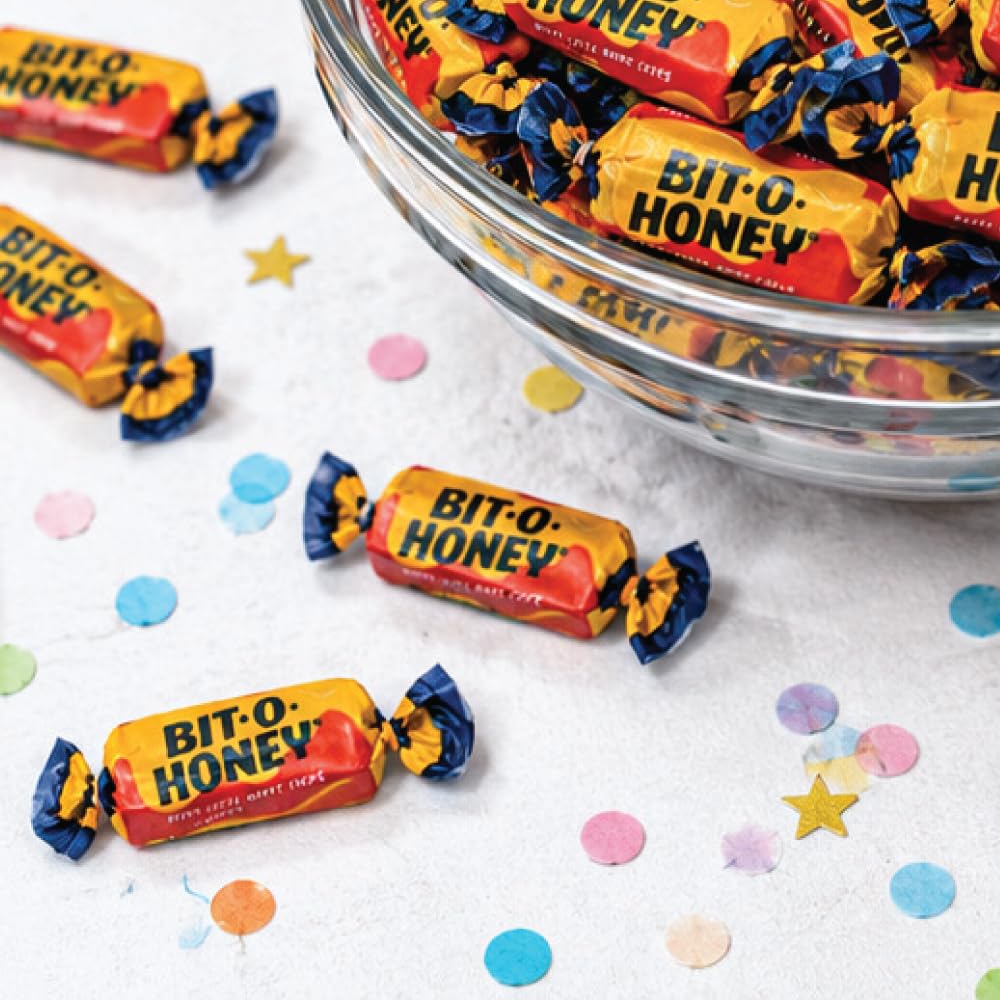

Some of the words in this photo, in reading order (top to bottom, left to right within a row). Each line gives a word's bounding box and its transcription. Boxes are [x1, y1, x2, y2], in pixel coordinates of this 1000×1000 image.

[628, 191, 806, 265] HONEY
[398, 519, 557, 578] HONEY
[153, 719, 313, 806] HONEY
